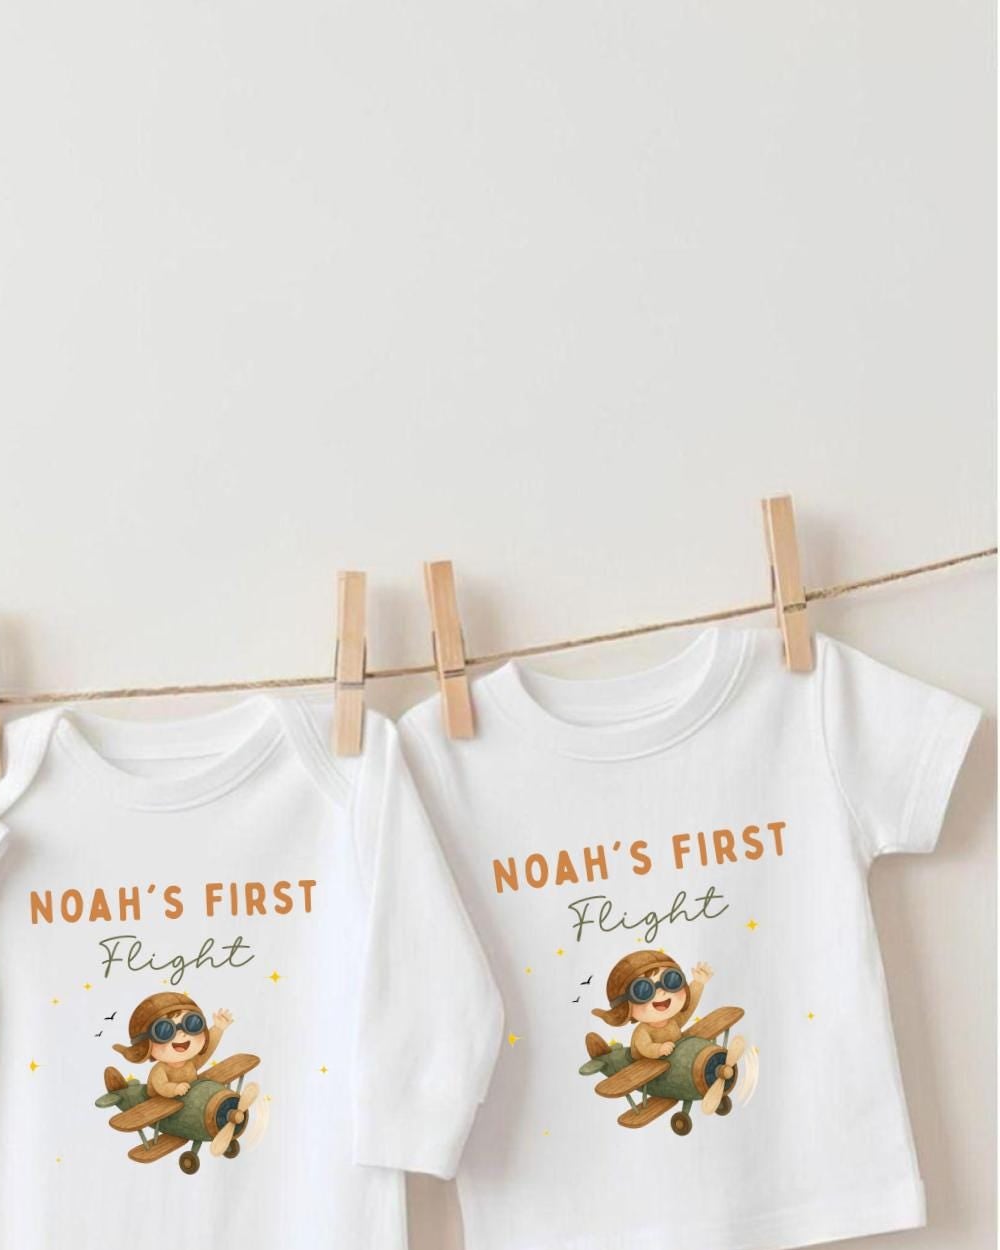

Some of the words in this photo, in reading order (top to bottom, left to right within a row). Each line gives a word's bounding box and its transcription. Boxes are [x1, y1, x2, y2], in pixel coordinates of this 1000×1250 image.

[491, 839, 653, 895] NOAH'S
[671, 820, 788, 870] FIRST
[29, 883, 186, 925] NOAH'S
[204, 879, 317, 918] FIRST
[567, 885, 730, 944] Flight
[98, 935, 256, 986] Flight
